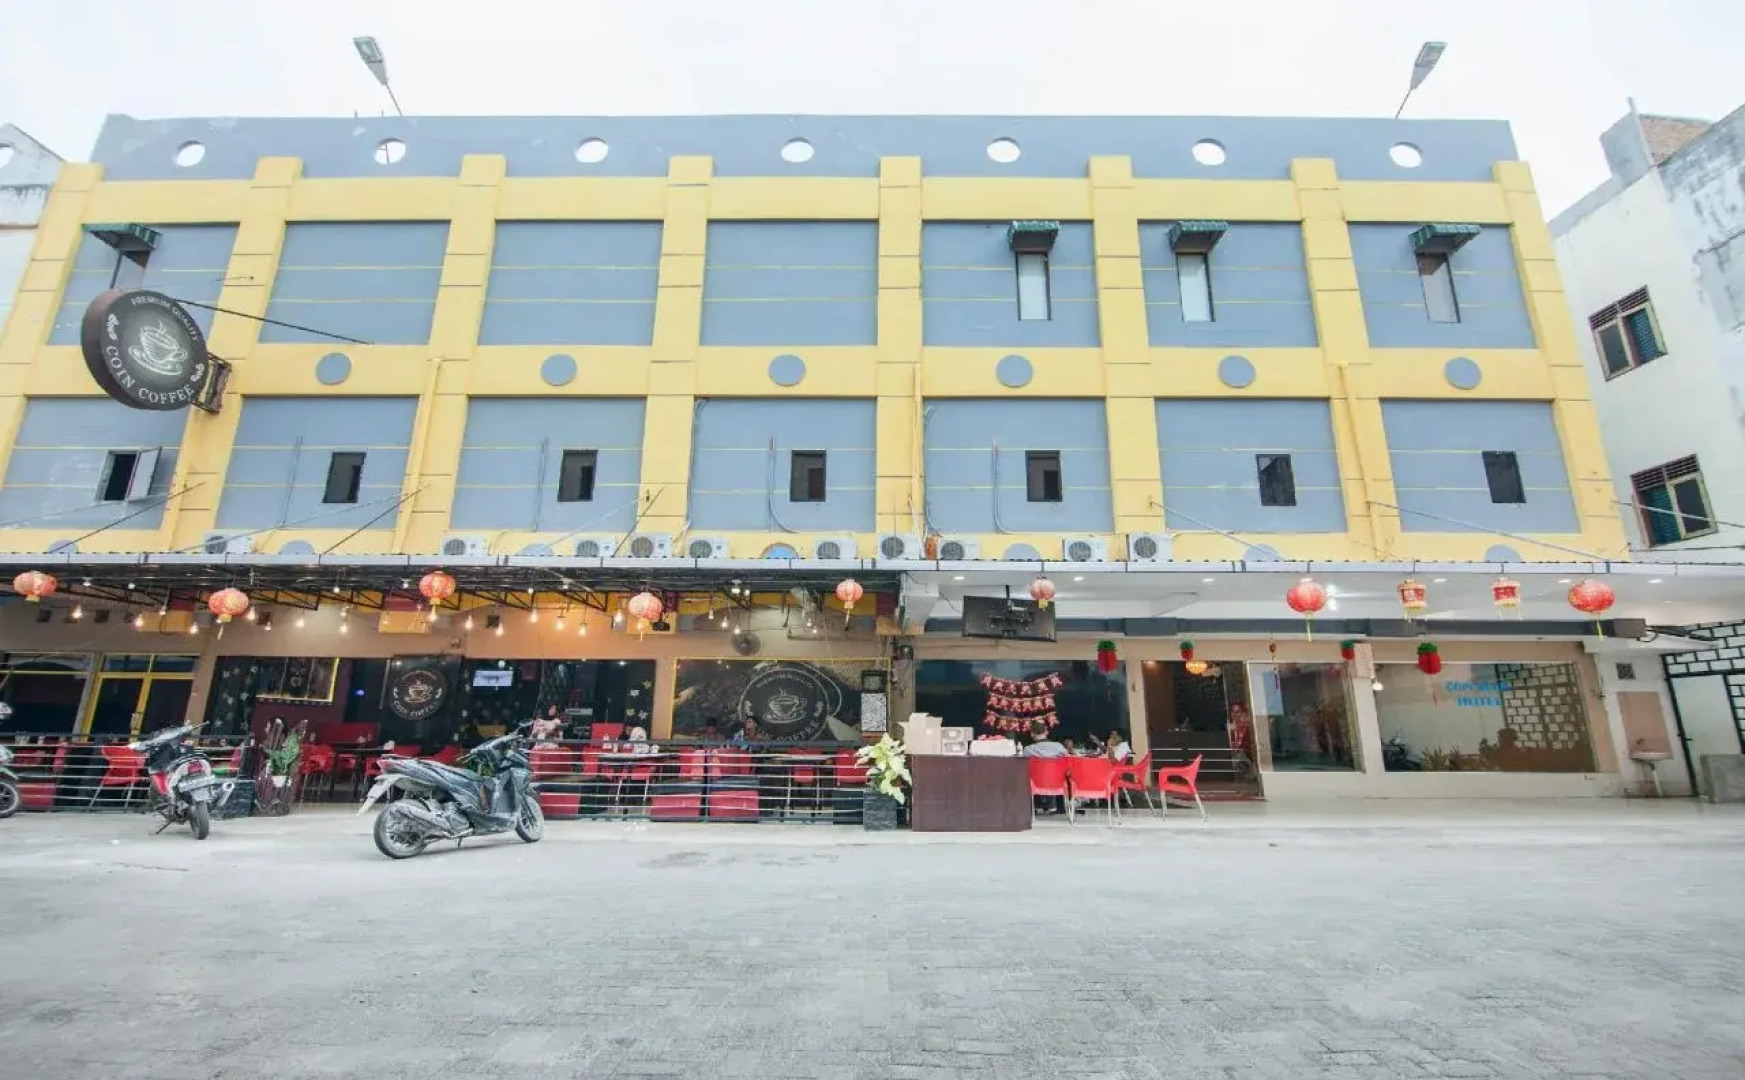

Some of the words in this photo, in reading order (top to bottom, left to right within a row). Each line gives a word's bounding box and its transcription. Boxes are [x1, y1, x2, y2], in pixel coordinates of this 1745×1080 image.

[130, 295, 171, 309] PREMIUM
[172, 307, 198, 341] QUALITY
[106, 345, 136, 388] COIN
[138, 384, 195, 405] COFFEE
